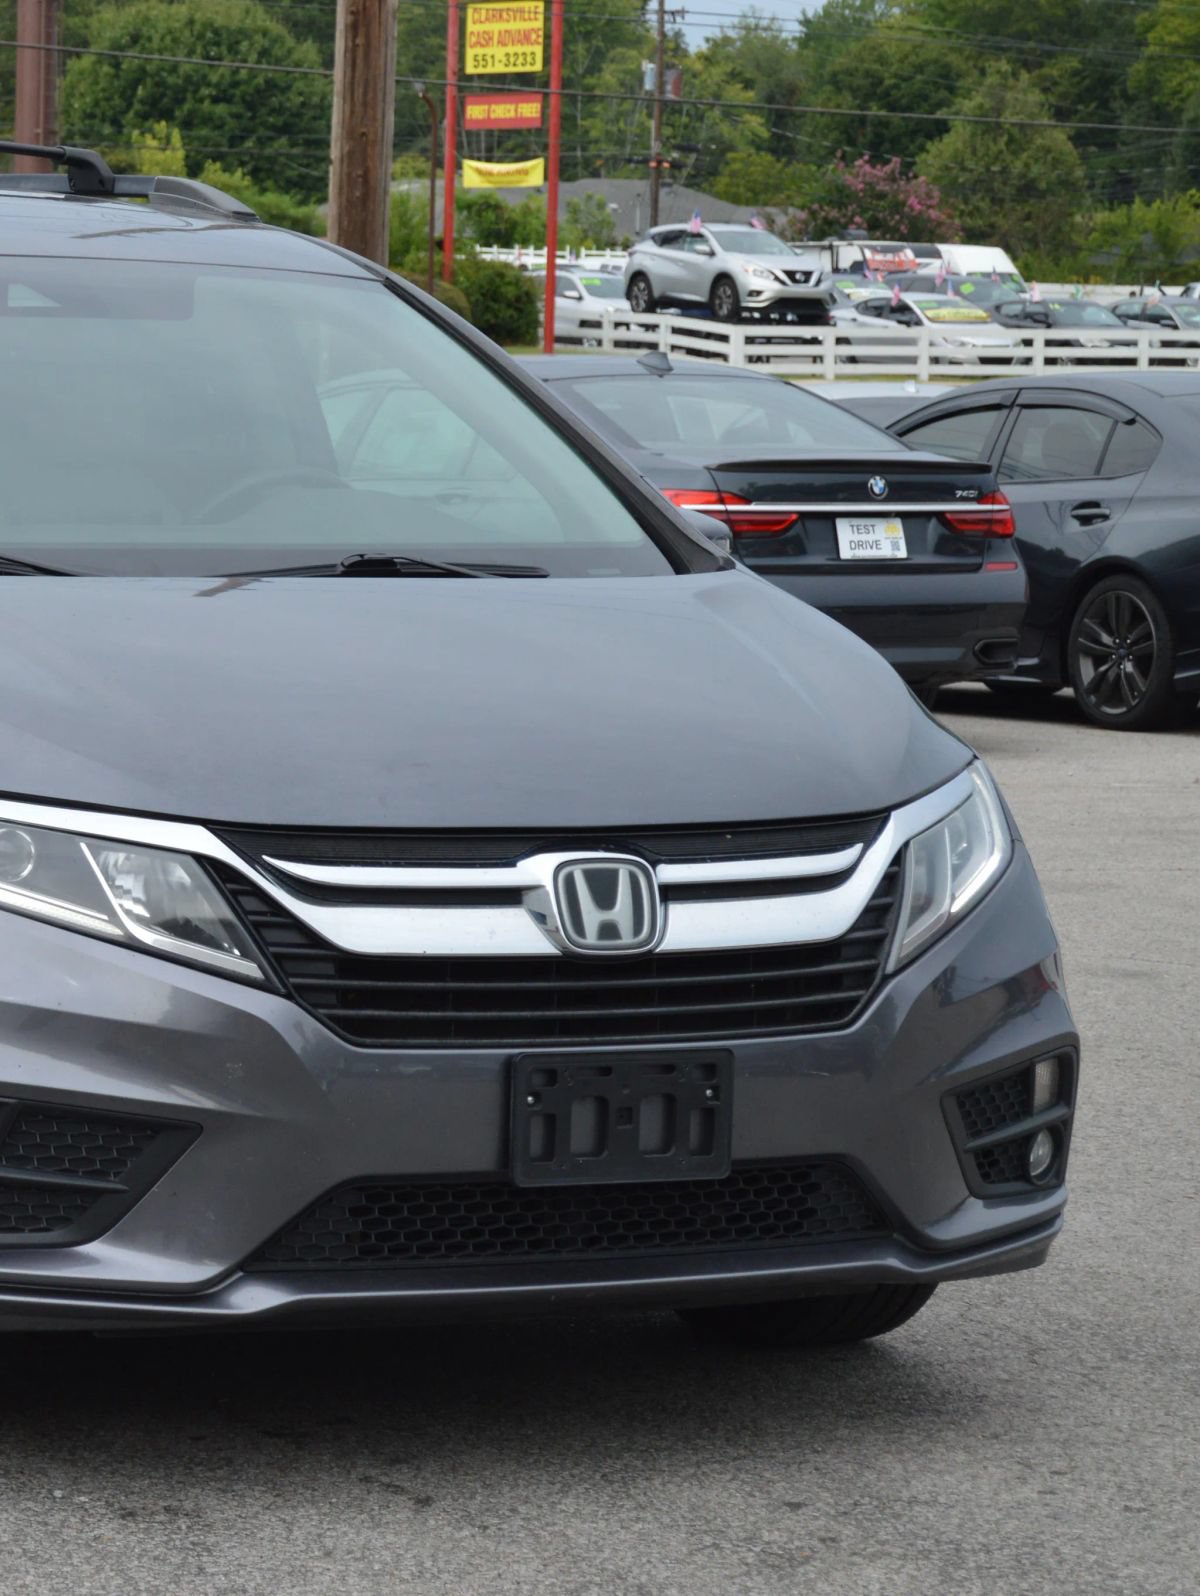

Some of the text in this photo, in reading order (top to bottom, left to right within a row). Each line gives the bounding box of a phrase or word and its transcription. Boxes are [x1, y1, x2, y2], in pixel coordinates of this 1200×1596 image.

[472, 6, 539, 25] CLARKSVILLE
[469, 28, 542, 48] CASH ADVANCE
[473, 51, 537, 69] 551-3233
[491, 104, 516, 119] CHECK
[849, 524, 876, 535] TEST
[849, 540, 883, 551] DRIVE
